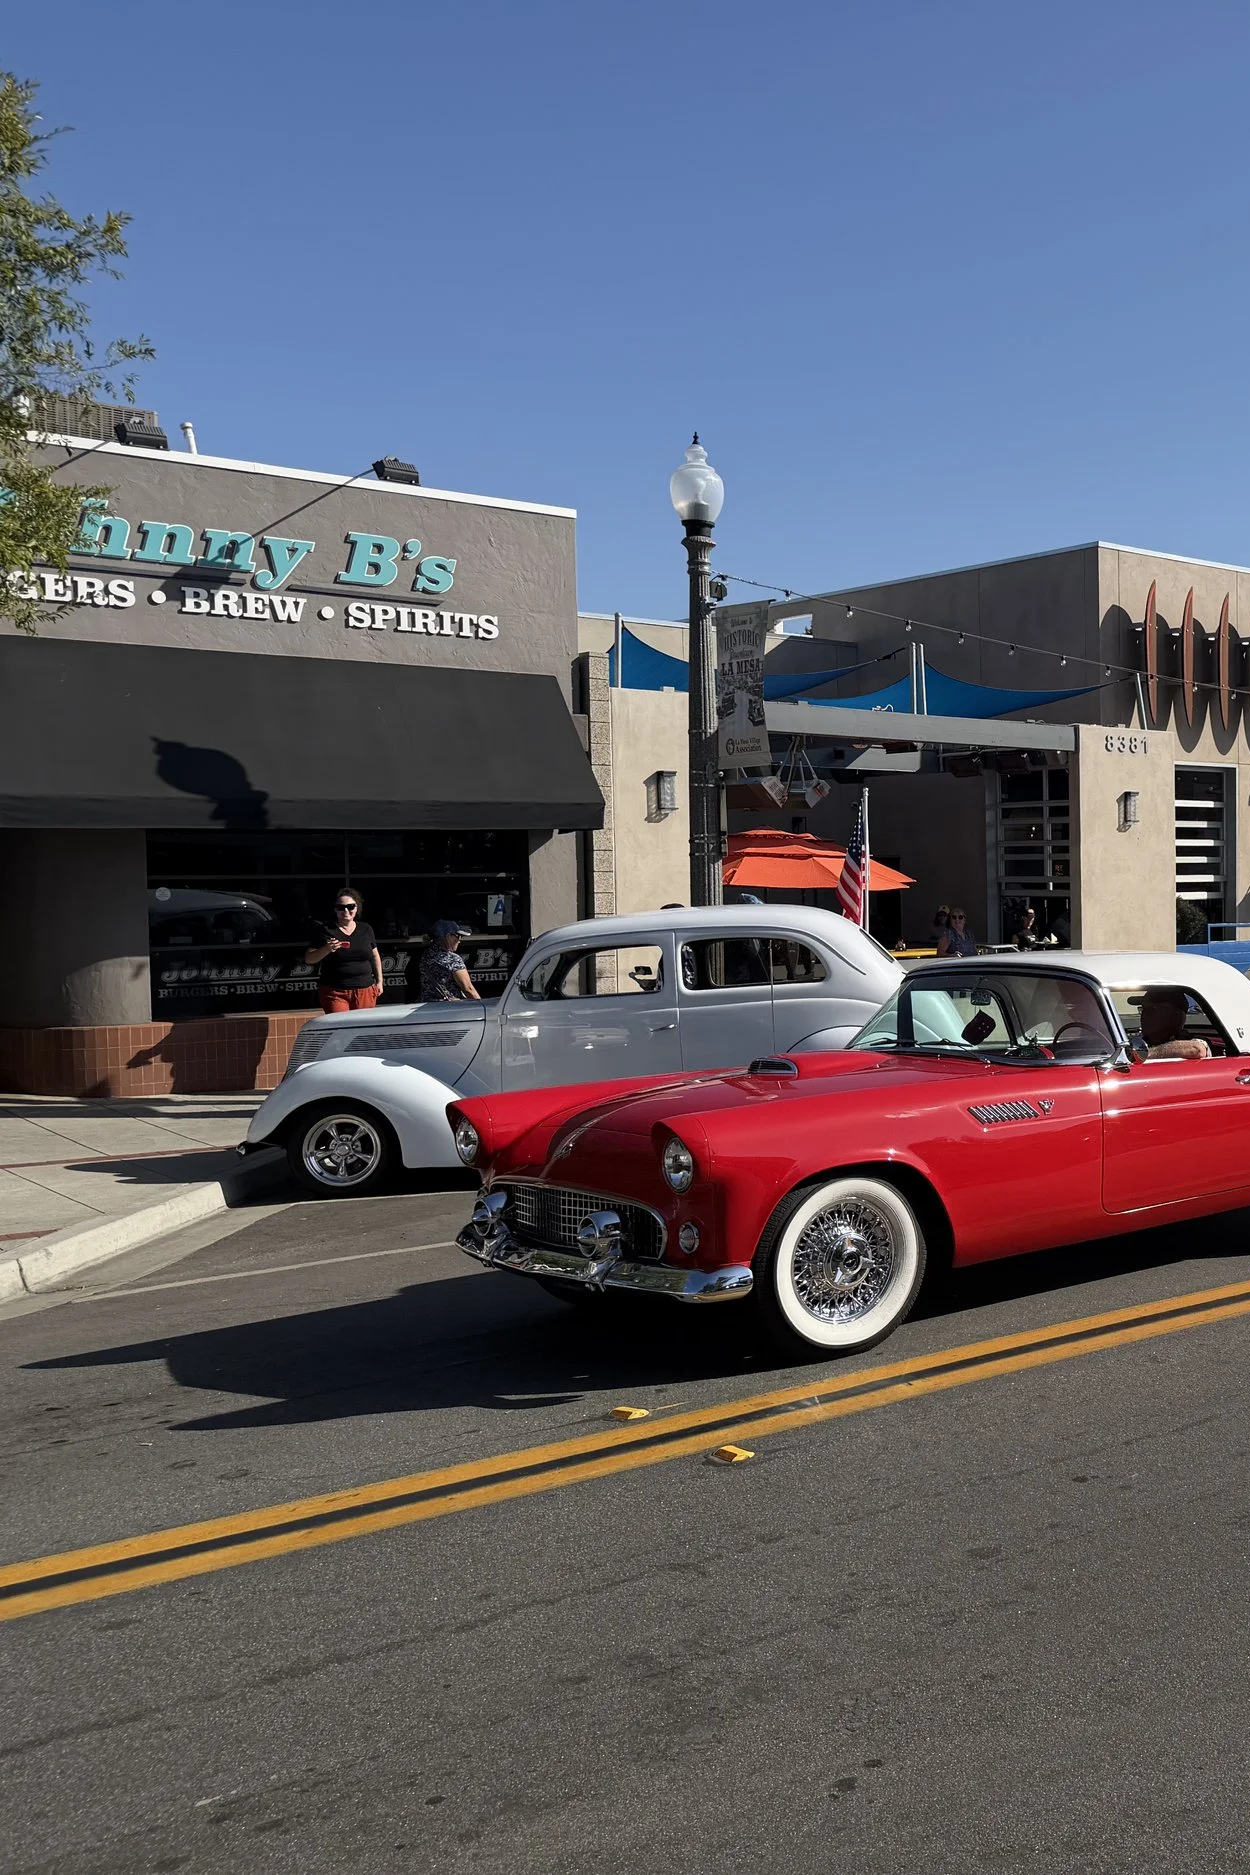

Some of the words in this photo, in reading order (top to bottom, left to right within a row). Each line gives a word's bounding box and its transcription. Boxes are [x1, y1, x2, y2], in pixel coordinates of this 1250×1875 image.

[0, 489, 315, 590] hnny
[337, 531, 457, 594] B's
[6, 570, 137, 609] GERS
[181, 586, 307, 623] BREW
[348, 602, 500, 640] SPIRITS
[724, 629, 761, 651] HISTORIC
[721, 662, 734, 676] LA
[736, 658, 761, 674] MESA
[1104, 735, 1147, 754] 8381
[236, 983, 279, 995] BREW
[285, 981, 318, 992] SPIR
